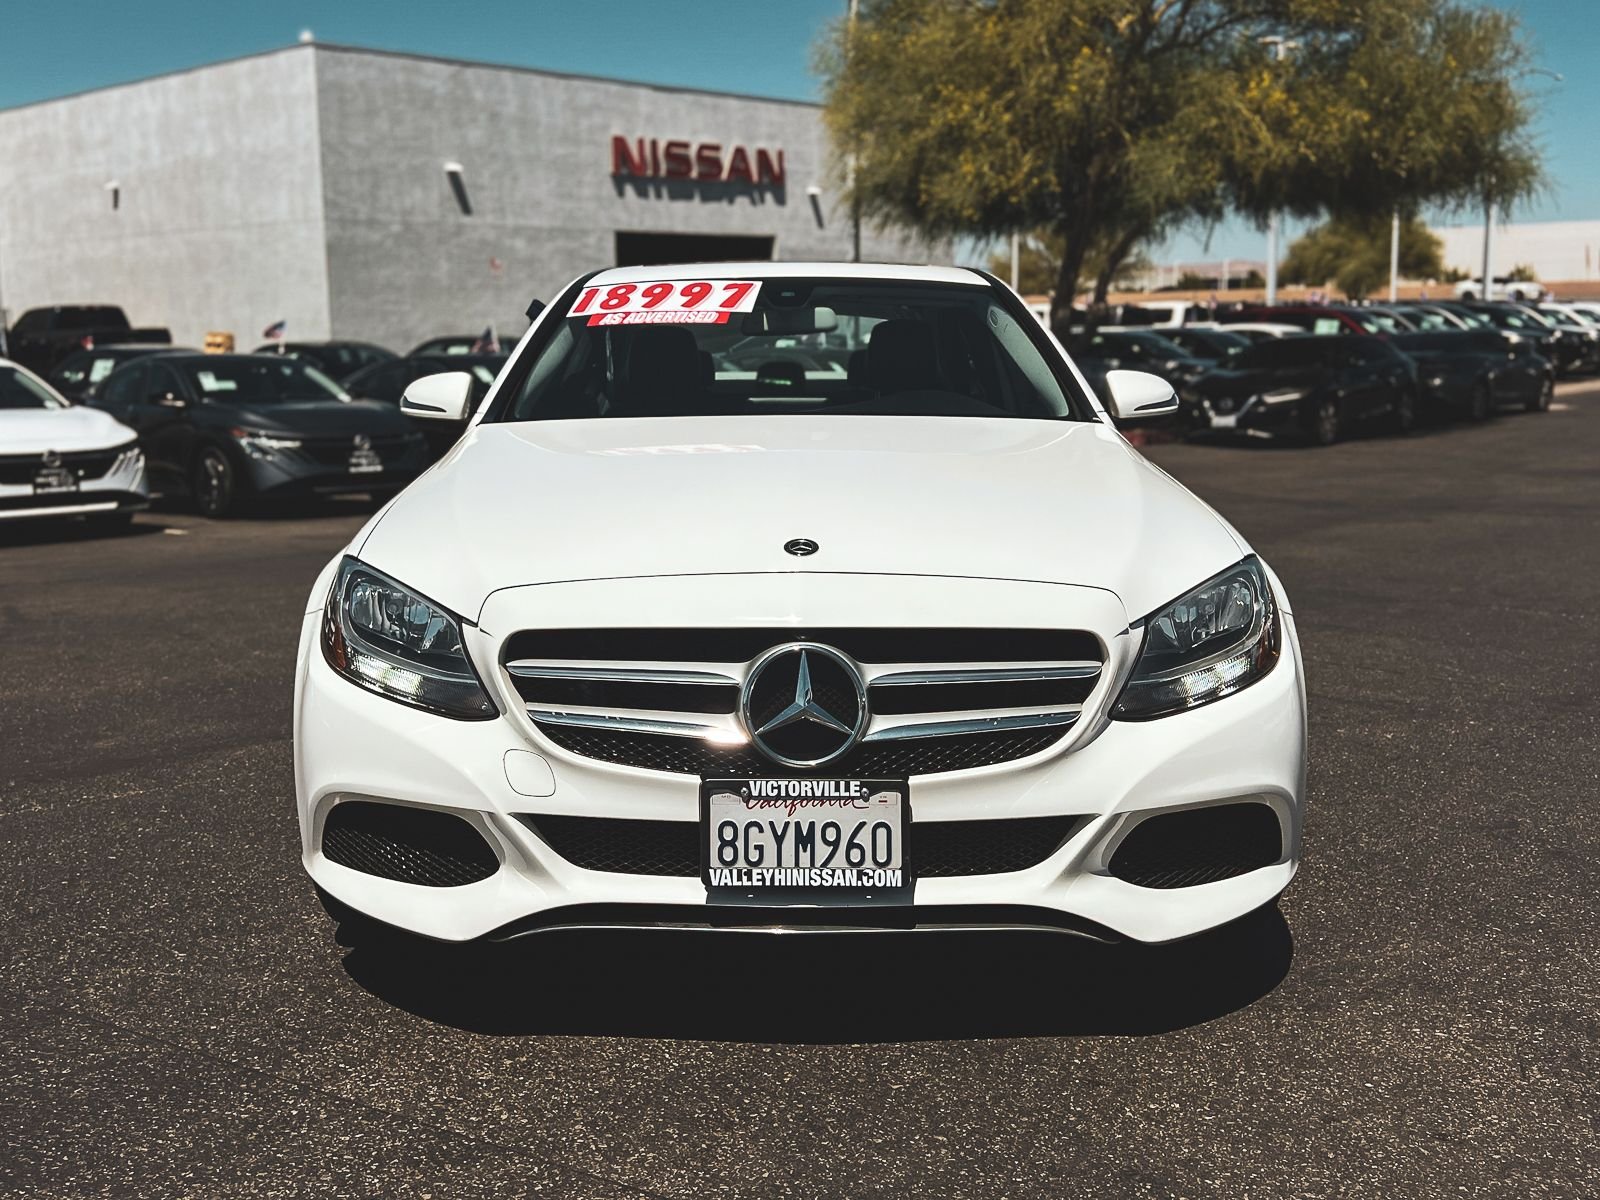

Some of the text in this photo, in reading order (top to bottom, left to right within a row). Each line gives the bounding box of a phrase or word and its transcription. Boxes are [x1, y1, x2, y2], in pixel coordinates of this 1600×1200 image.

[611, 135, 785, 185] NISSAN
[572, 282, 757, 314] 18997
[600, 311, 720, 325] AS ADVERTISED
[749, 780, 861, 797] VICTORVILLE
[717, 820, 893, 868] 8GYM960
[708, 868, 902, 887] VALLEYHINISSAN.COM
